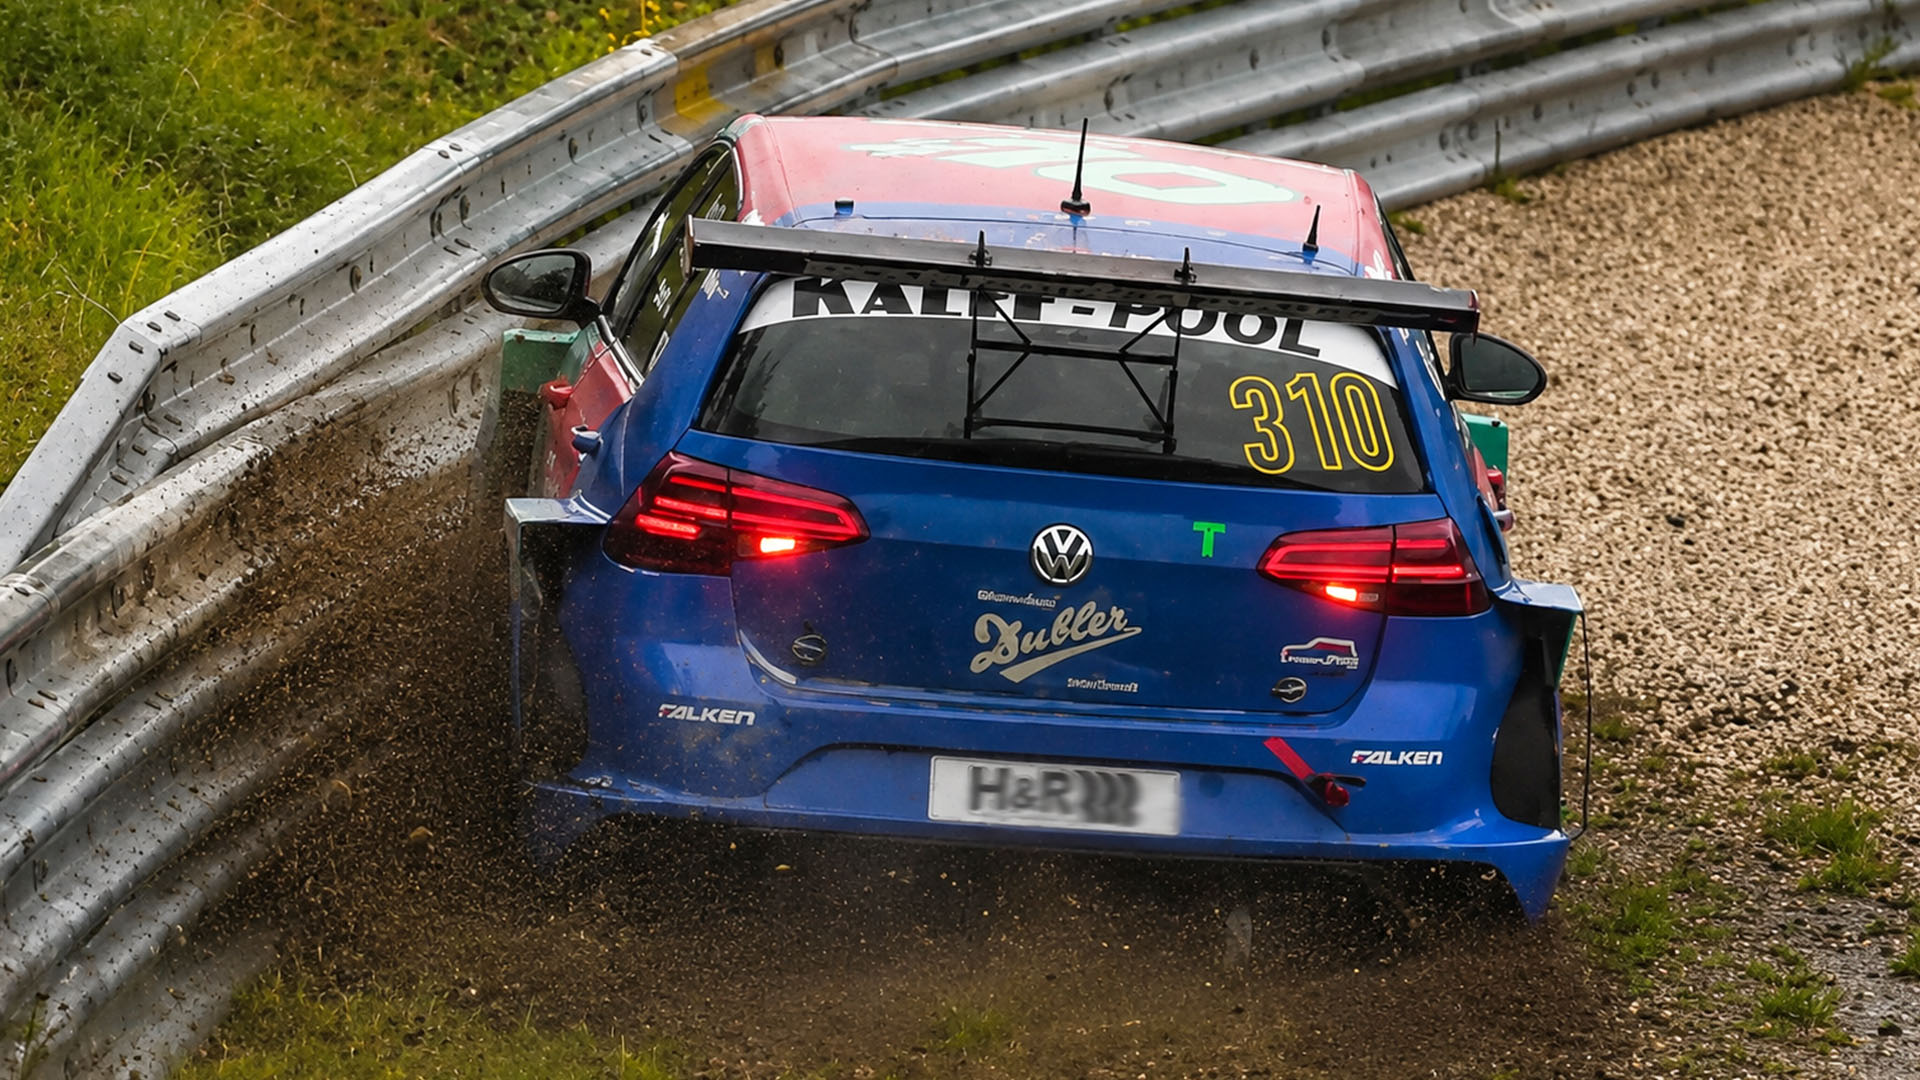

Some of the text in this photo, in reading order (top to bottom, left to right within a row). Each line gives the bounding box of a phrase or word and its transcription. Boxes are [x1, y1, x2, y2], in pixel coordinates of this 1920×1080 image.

[1229, 372, 1394, 474] 310
[1193, 521, 1226, 558] T
[658, 703, 756, 726] FALKEN
[1351, 750, 1443, 765] FALKEN
